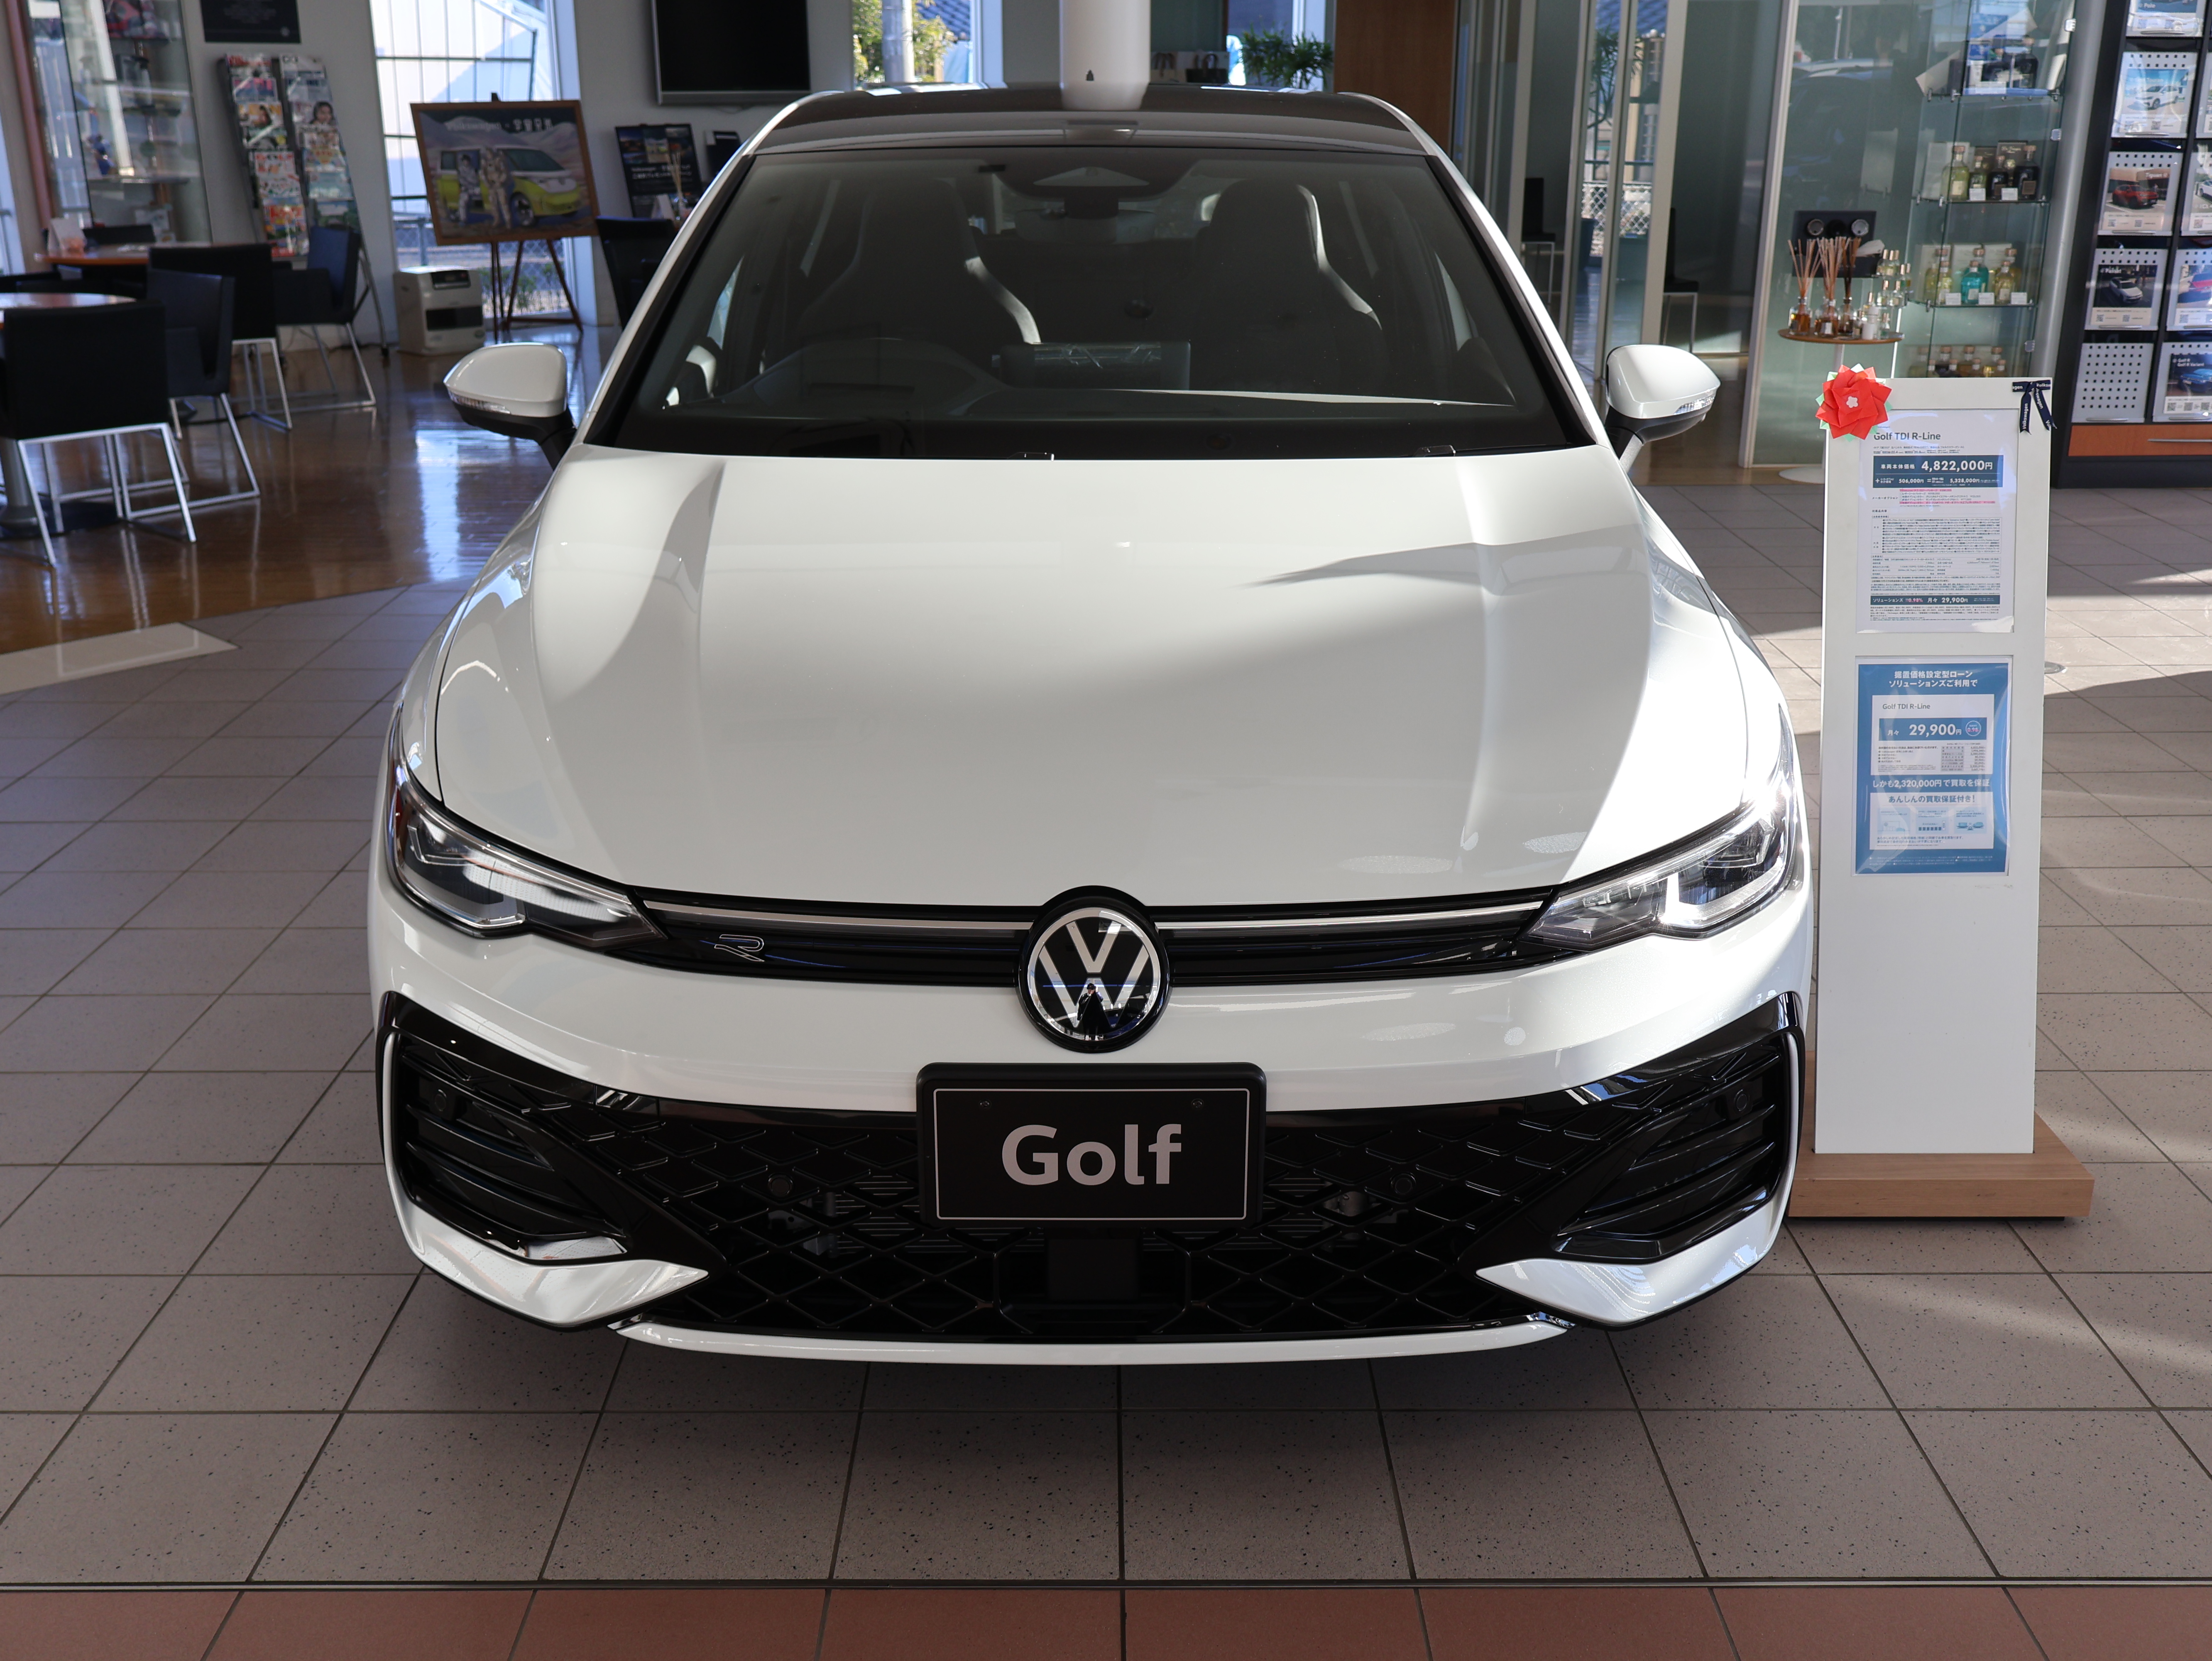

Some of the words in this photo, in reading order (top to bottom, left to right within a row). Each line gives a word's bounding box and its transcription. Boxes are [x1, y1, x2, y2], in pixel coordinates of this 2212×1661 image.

[1874, 432, 1893, 440] Golf
[1921, 460, 1993, 473] 4,822,000円
[1894, 671, 1973, 679] 据置価格設定型ローン
[1889, 679, 1978, 688] ソリューションズご利用で
[1909, 723, 1962, 738] 29,900円
[1001, 1124, 1182, 1186] Golf
